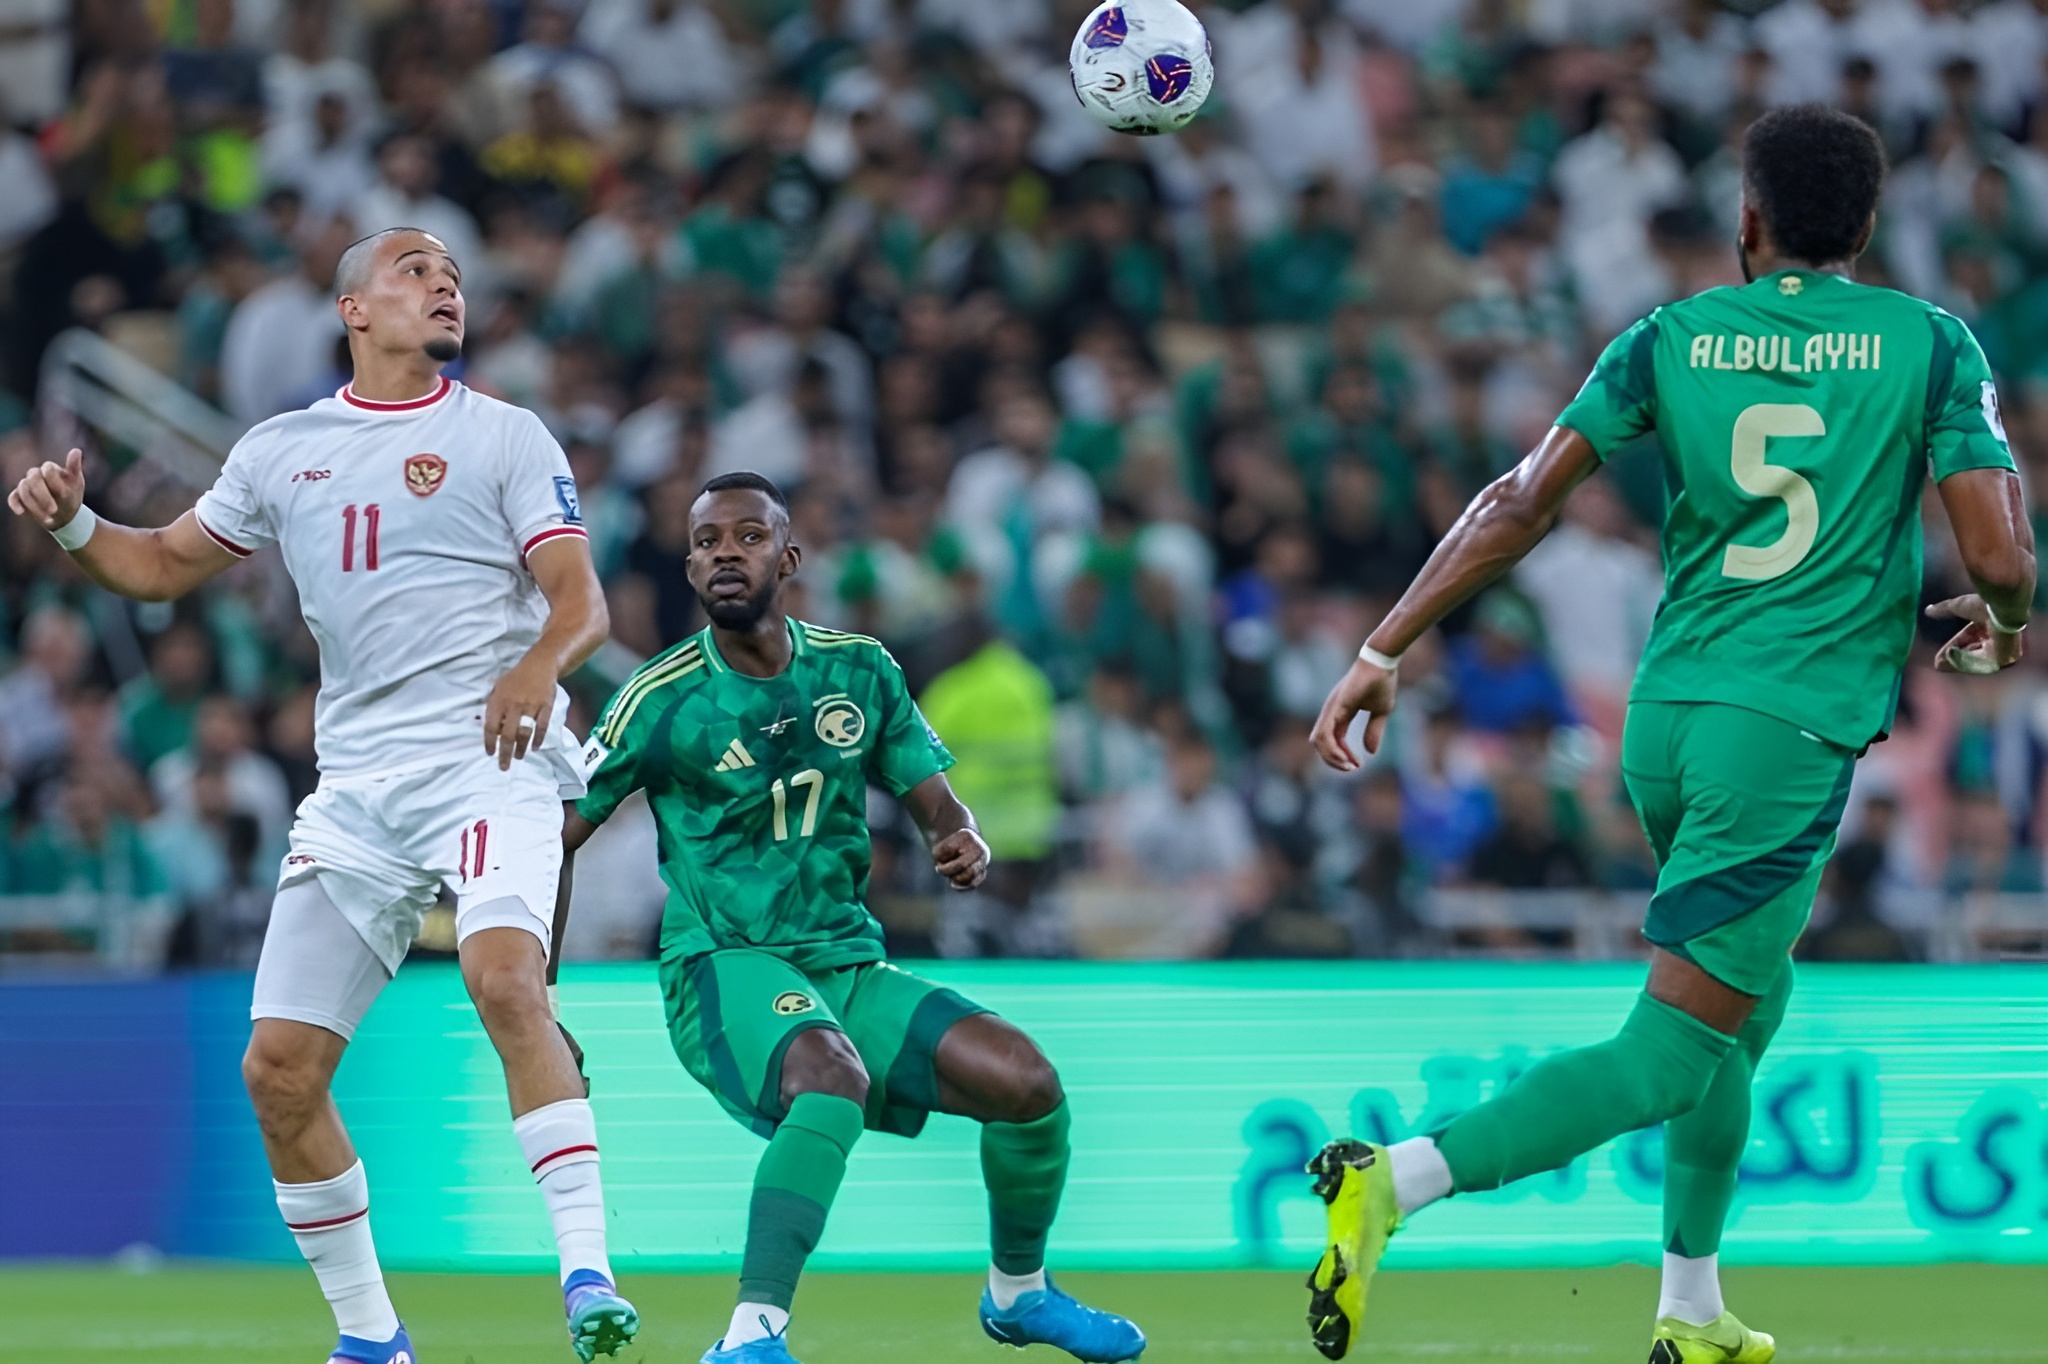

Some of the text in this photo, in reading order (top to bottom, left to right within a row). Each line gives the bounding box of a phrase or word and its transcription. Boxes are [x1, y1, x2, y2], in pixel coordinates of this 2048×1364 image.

[1689, 332, 1881, 373] ALBULAYHI
[1721, 403, 1826, 580] 5
[342, 503, 380, 572] 11
[771, 768, 824, 841] 17
[459, 819, 489, 883] 11
